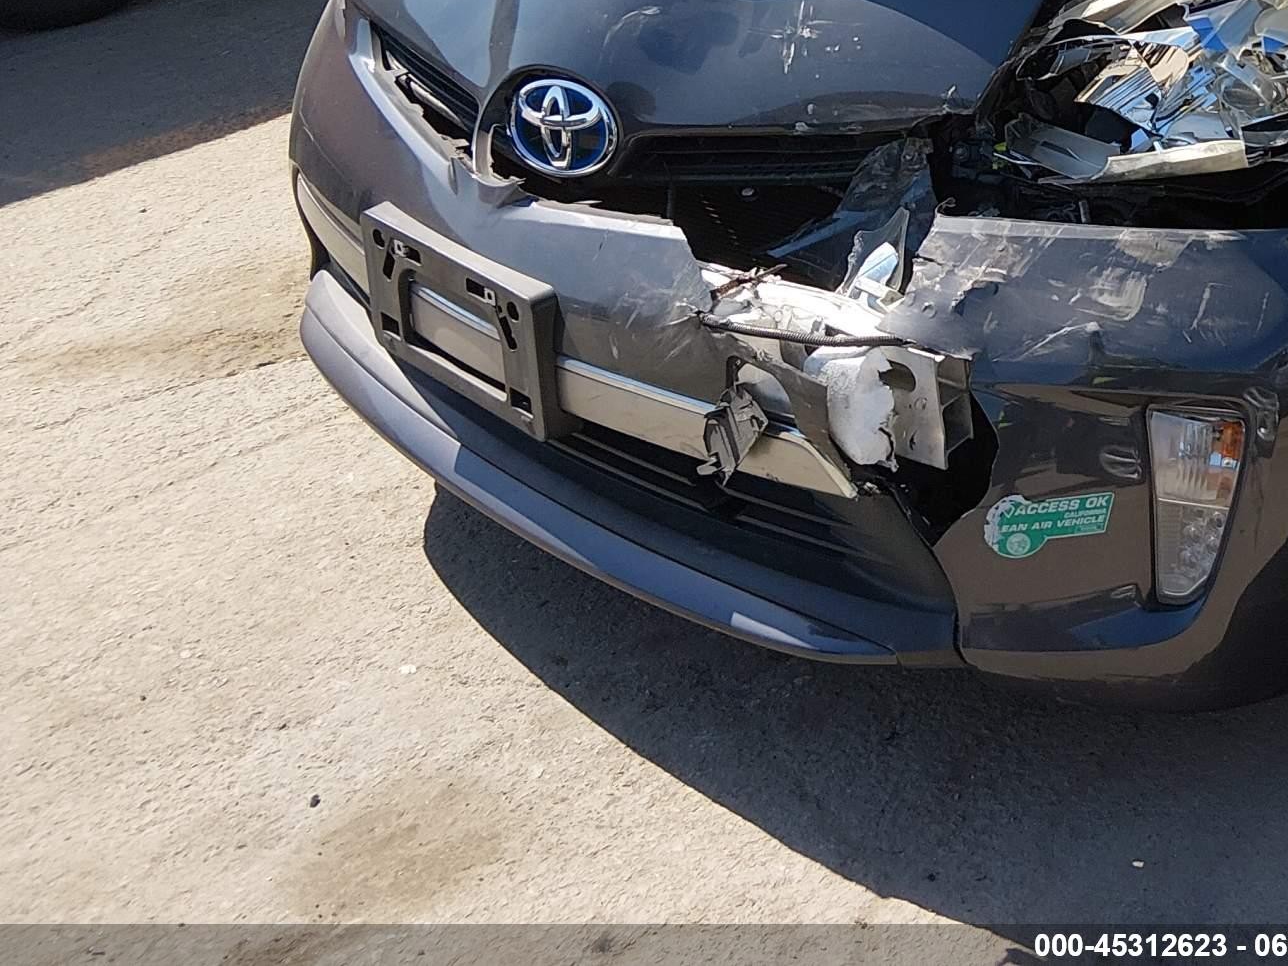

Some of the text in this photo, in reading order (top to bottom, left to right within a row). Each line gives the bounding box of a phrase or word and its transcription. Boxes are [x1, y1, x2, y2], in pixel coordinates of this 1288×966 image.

[1014, 495, 1110, 516] ACCESS OK
[1031, 520, 1053, 530] AIR
[1057, 514, 1106, 528] VEHICLE
